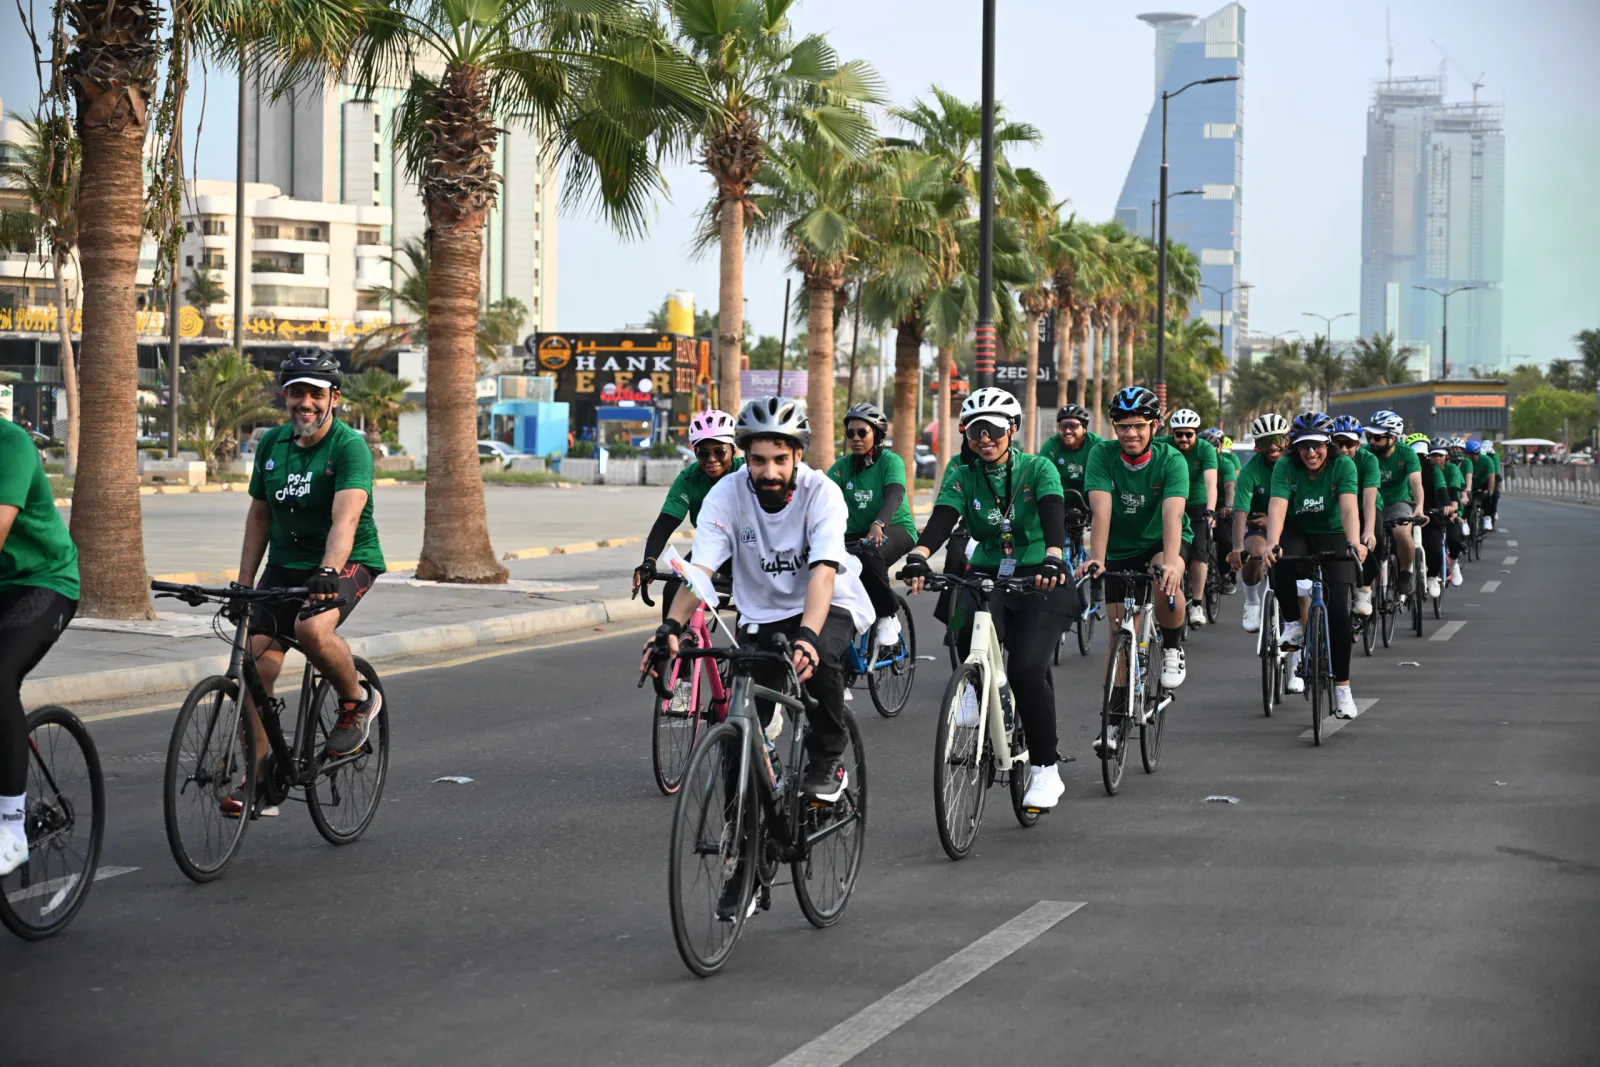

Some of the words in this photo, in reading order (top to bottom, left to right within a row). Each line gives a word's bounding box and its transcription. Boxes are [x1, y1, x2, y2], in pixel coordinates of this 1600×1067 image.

[15, 302, 58, 331] POINT
[575, 356, 672, 372] HANK
[287, 471, 313, 486] اليوم
[1303, 495, 1324, 507] اليوم
